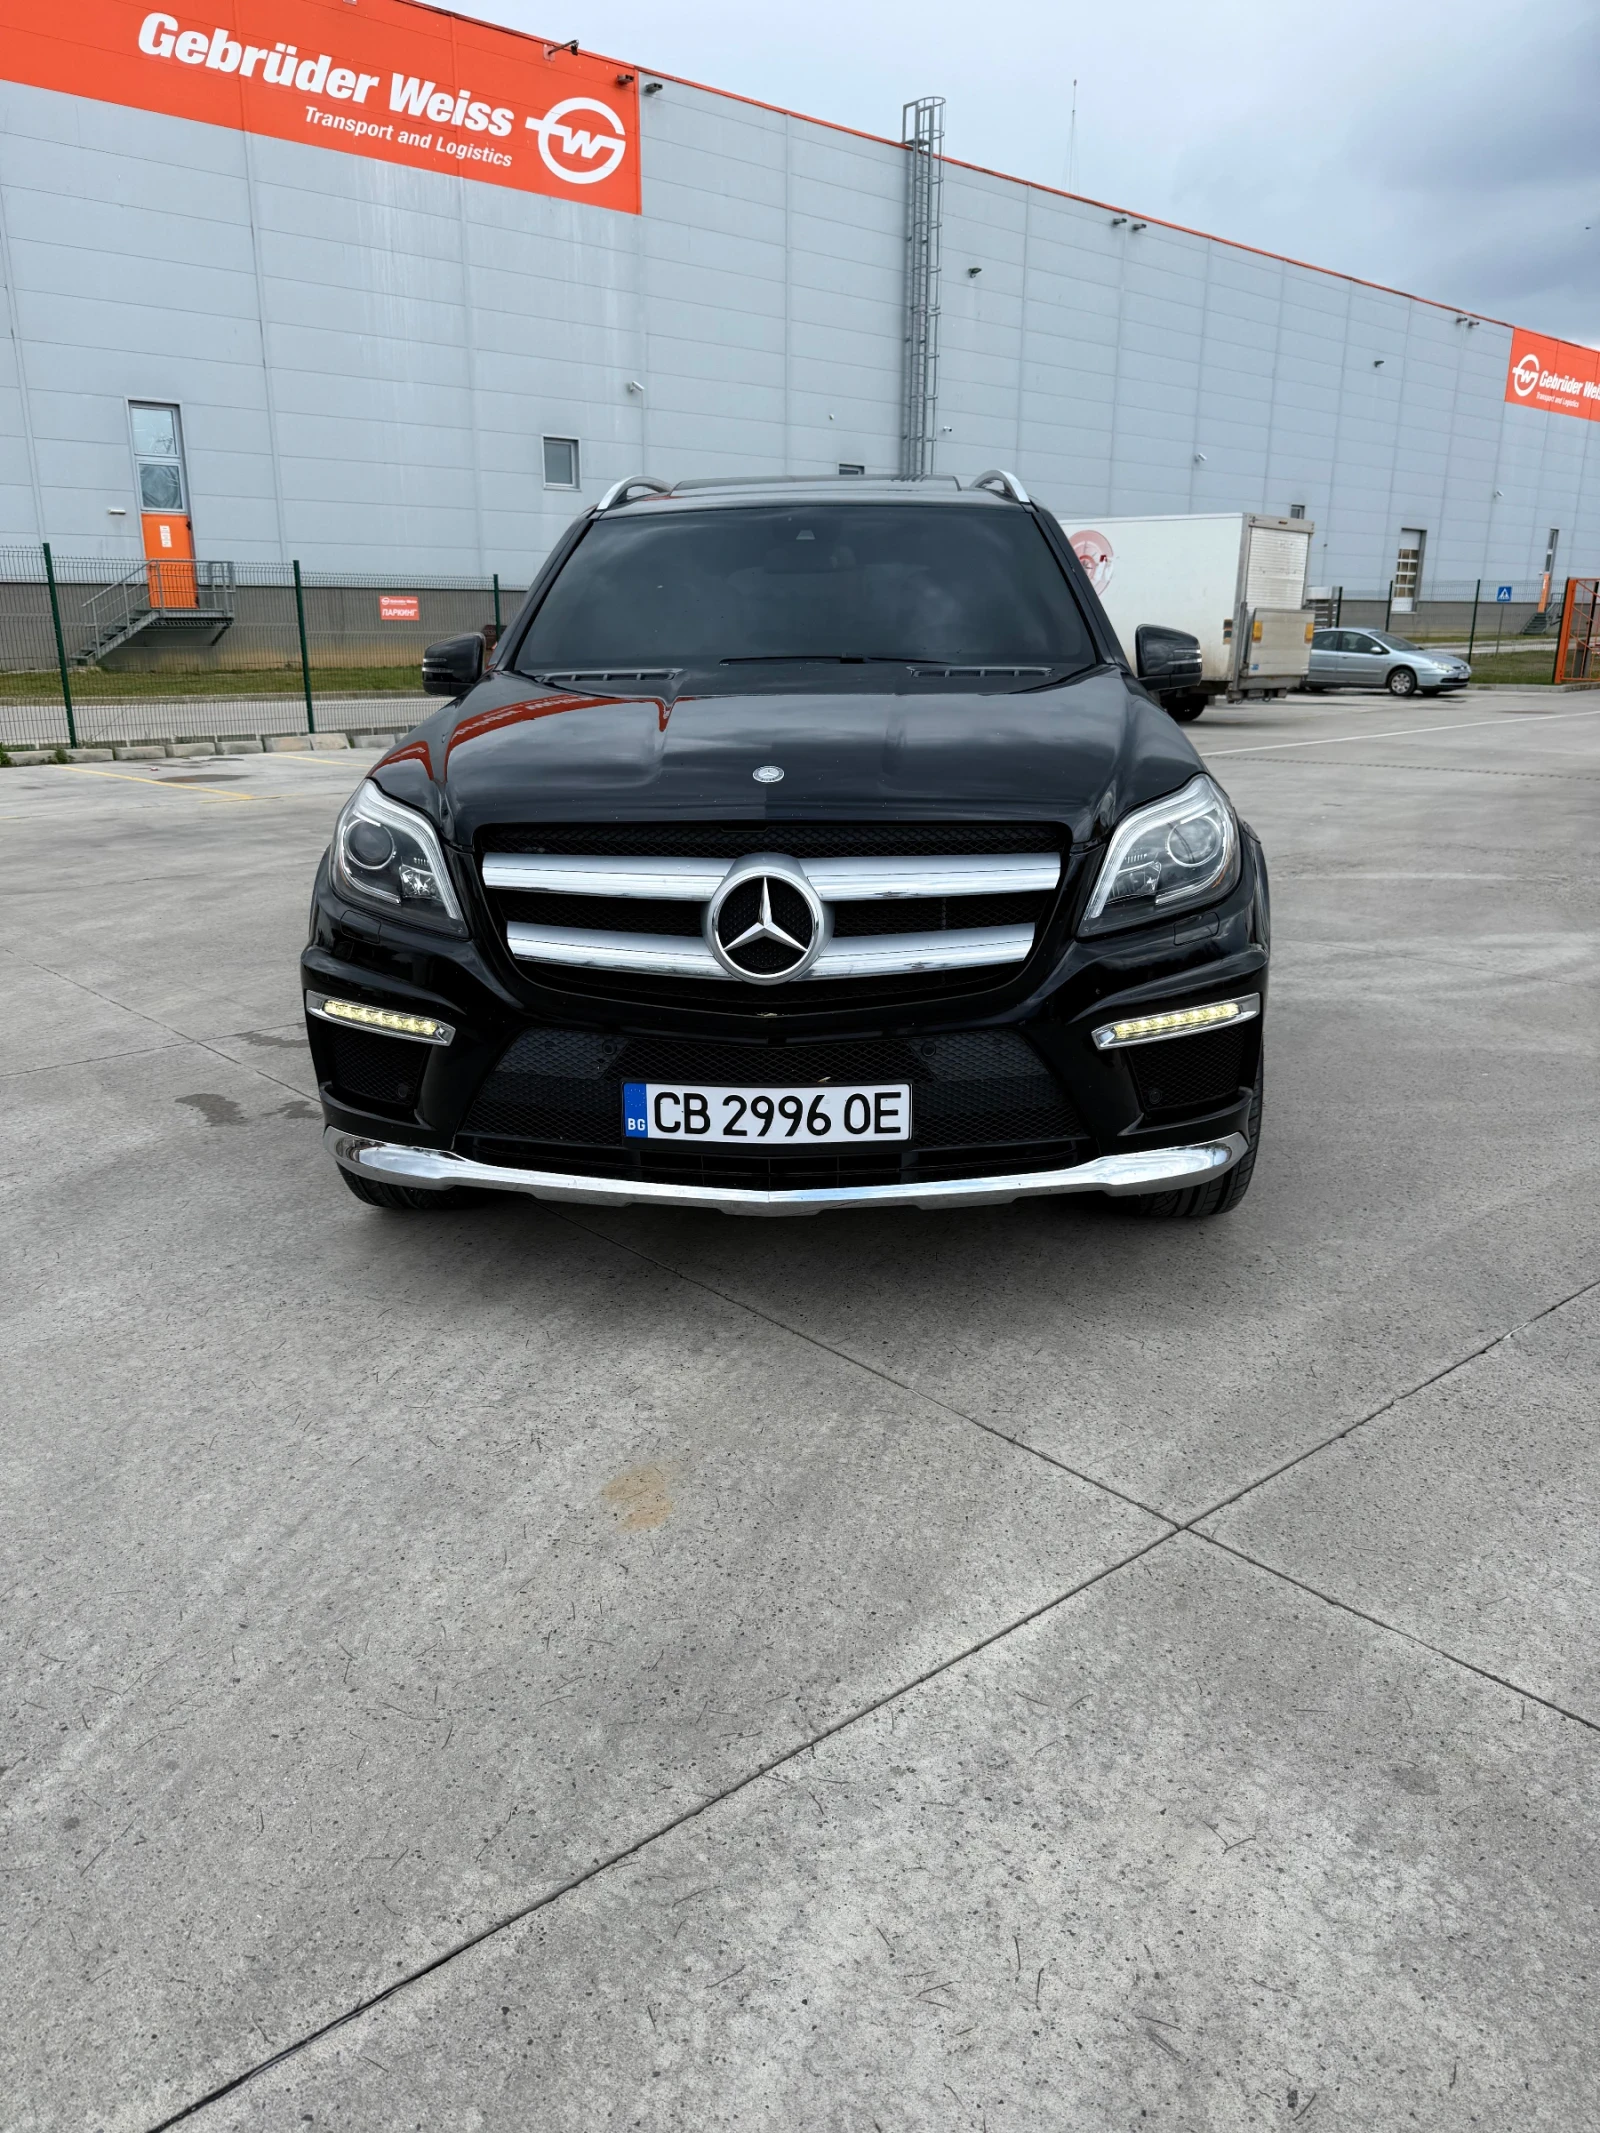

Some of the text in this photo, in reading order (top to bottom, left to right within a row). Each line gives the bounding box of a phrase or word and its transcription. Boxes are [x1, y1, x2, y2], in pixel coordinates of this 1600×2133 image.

[138, 12, 515, 137] Gebrüder Weiss
[304, 105, 513, 167] Transport and Logistics
[1539, 370, 1584, 395] Gebrüder
[382, 608, 418, 617] ПАРКИНГ
[627, 1117, 646, 1131] BG
[653, 1091, 711, 1135] CB
[722, 1094, 832, 1137] 2996
